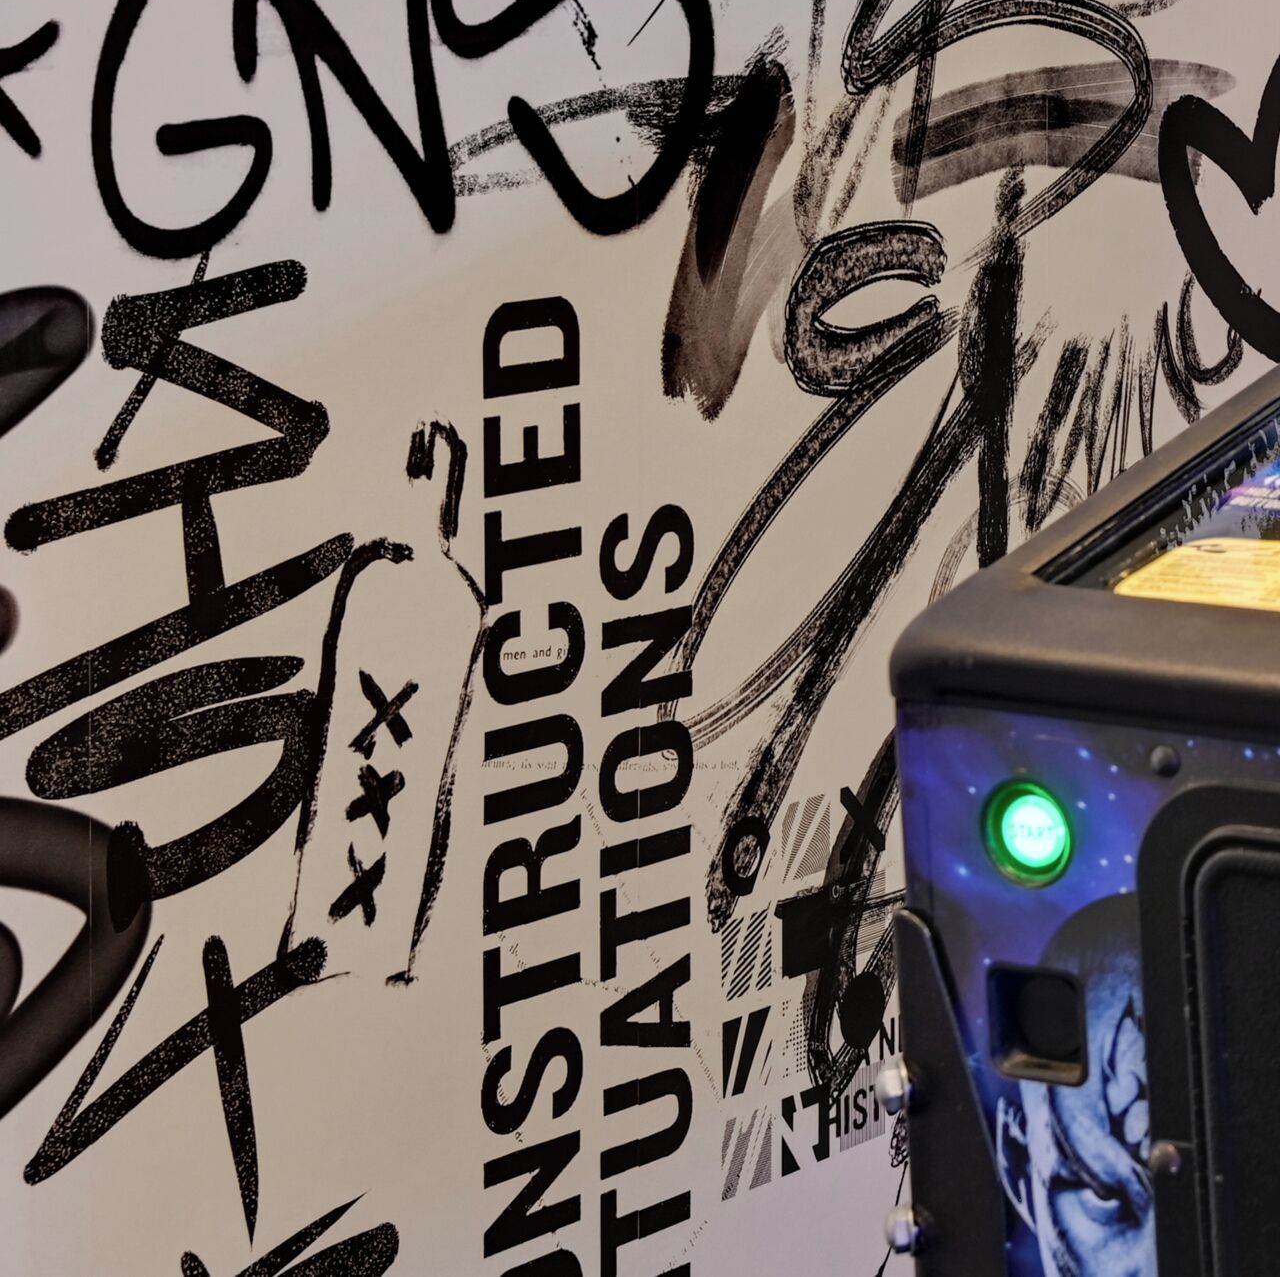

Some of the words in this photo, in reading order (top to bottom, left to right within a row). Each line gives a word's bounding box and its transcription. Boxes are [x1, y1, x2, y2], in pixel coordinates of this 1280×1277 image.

[503, 650, 527, 661] men
[532, 645, 552, 659] and
[600, 504, 695, 1277] TUATIONS
